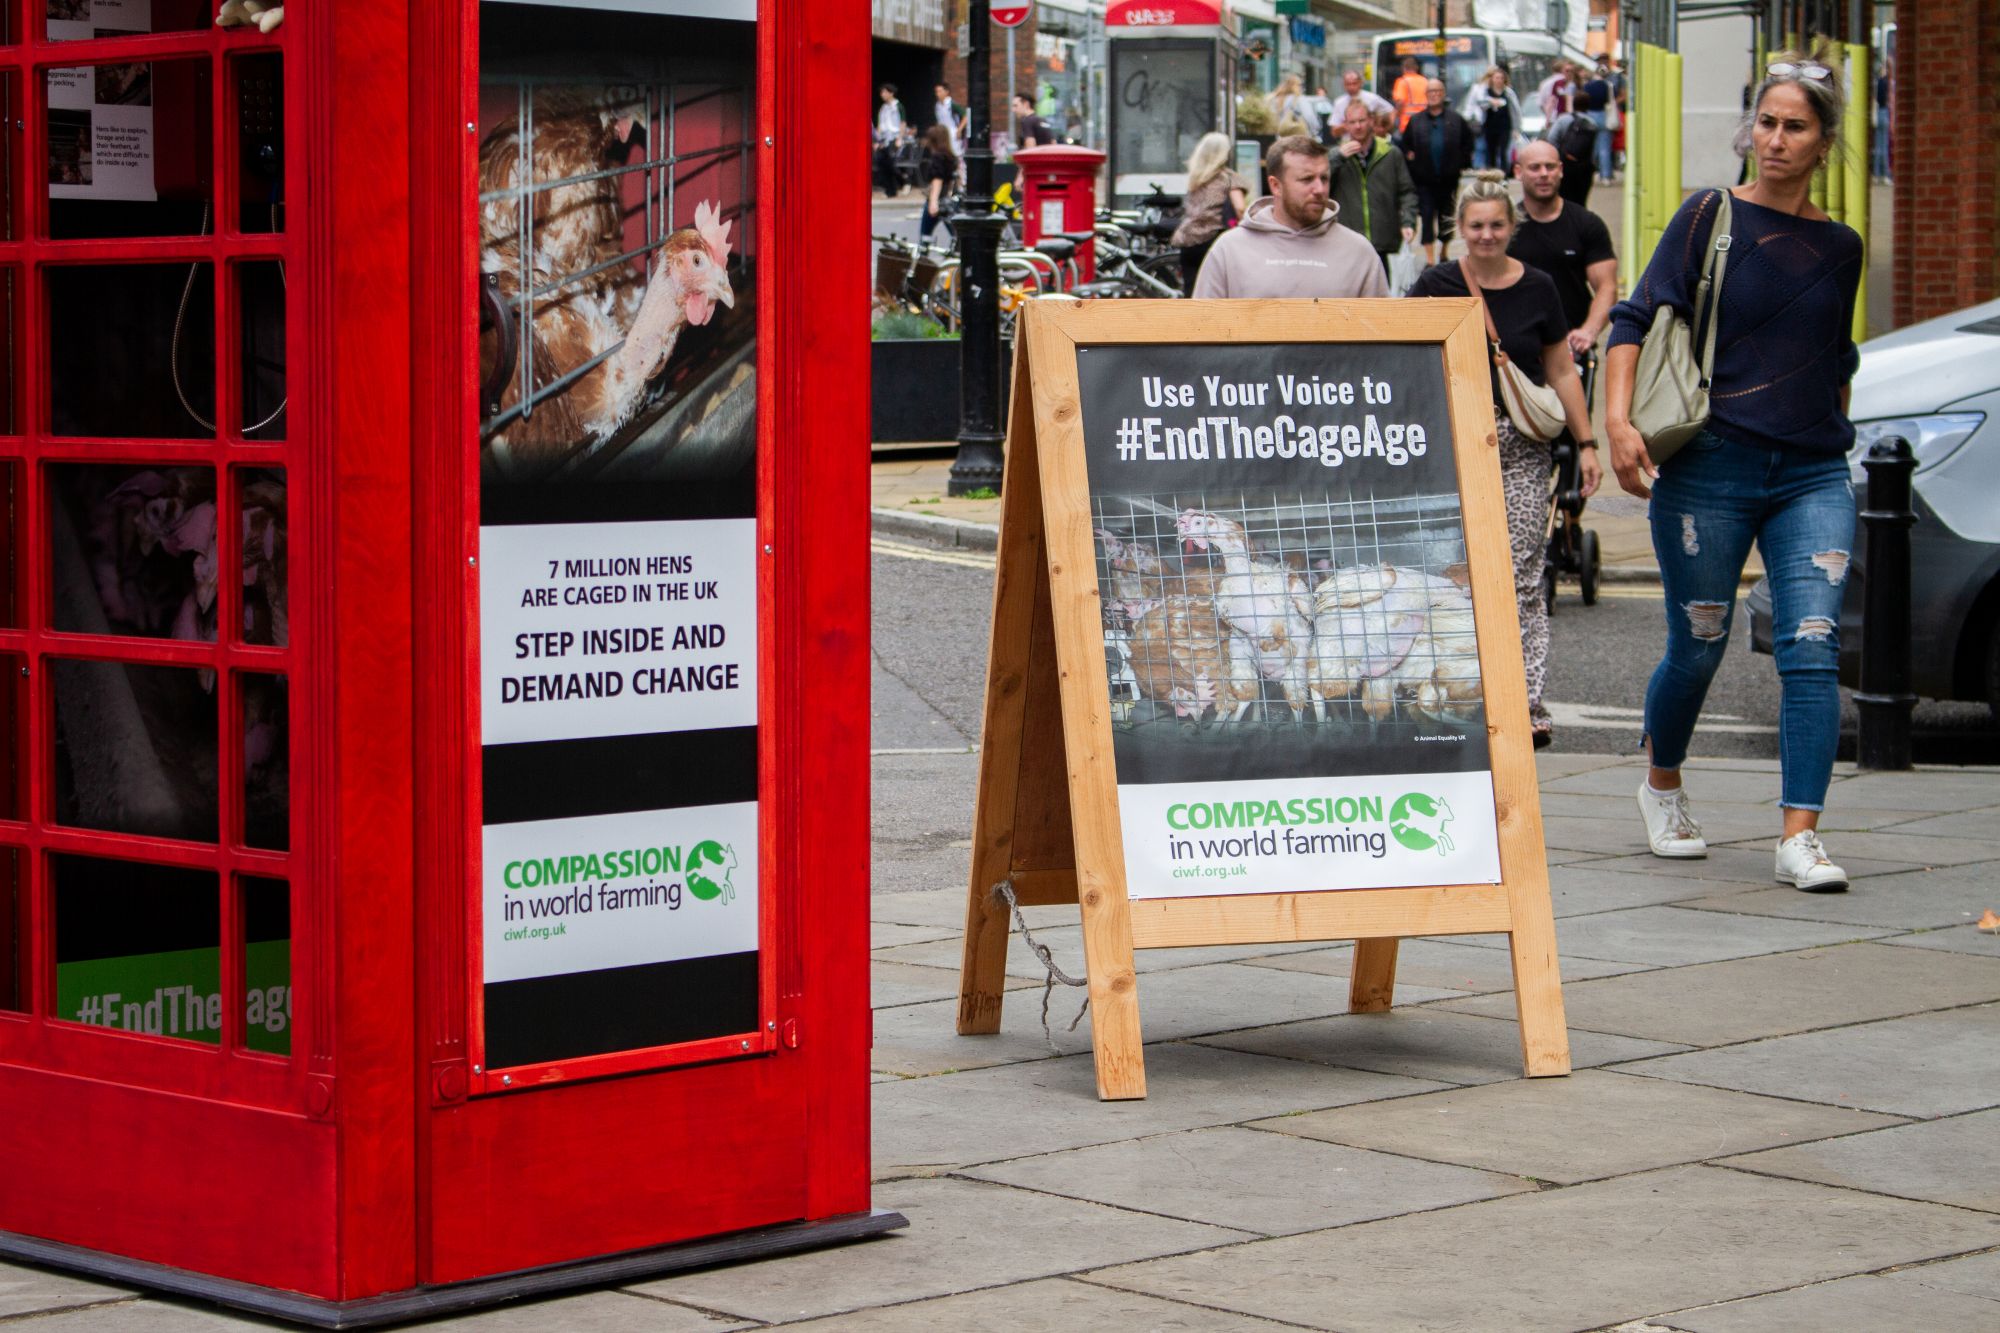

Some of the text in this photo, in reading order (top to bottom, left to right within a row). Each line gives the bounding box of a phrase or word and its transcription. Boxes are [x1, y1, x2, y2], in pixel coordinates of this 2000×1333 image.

[1142, 374, 1392, 408] Use Your Voice to
[1116, 414, 1427, 467] #EndTheCageAge
[548, 555, 693, 579] 7 MILLION HENS
[521, 581, 718, 608] ARE CAGED IN THE UK
[515, 623, 726, 660] STEP INSIDE AND
[501, 663, 740, 705] DEMAND CHANGE
[1438, 734, 1457, 742] Equality
[1166, 796, 1384, 831] COMPASSION
[1169, 827, 1387, 860] in world farming
[503, 845, 682, 890] COMPASSION
[1172, 863, 1248, 879] ciwf.org.uk
[504, 879, 682, 921] in world farming
[504, 922, 566, 941] ciwf.org.uk
